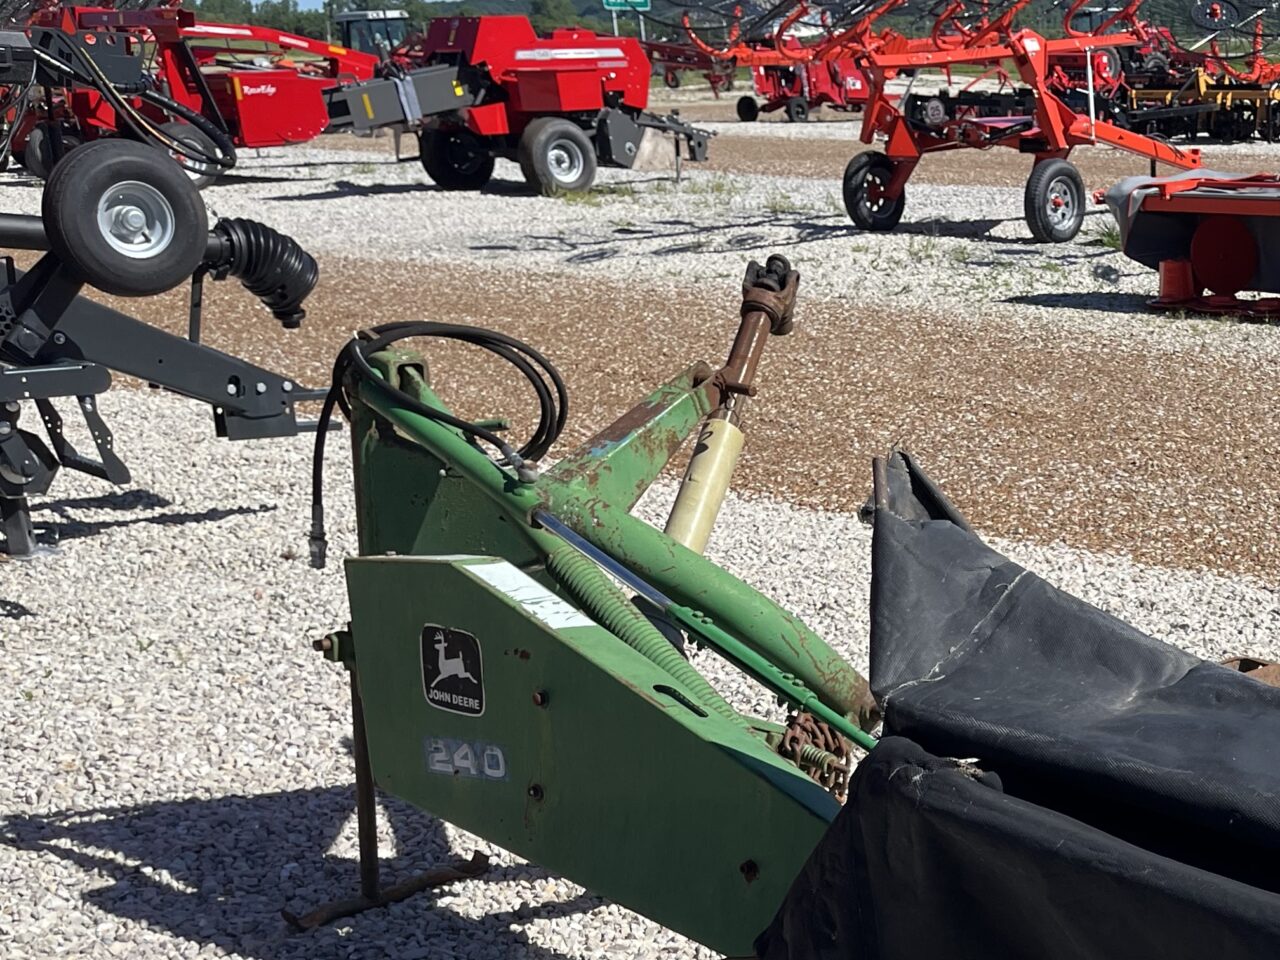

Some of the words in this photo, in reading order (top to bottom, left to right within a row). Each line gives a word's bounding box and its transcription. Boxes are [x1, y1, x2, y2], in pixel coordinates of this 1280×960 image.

[428, 689, 452, 703] JOHN
[452, 694, 481, 710] DEERE
[428, 738, 506, 778] 240
